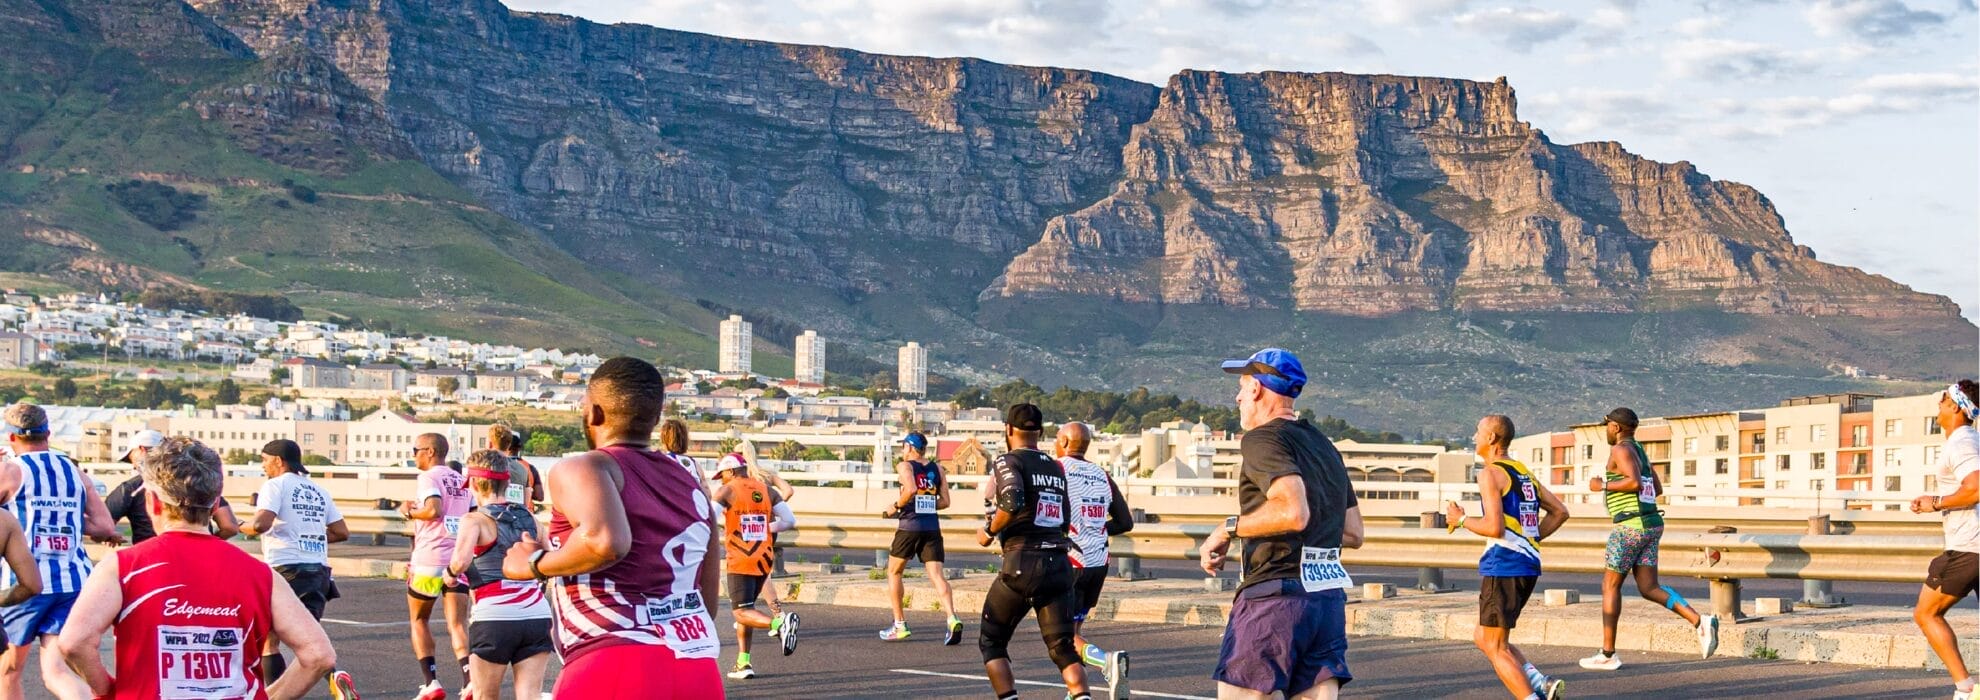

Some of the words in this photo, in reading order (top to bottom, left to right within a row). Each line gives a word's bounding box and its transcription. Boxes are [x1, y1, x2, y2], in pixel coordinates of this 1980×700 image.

[47, 535, 69, 551] 153
[1302, 563, 1346, 581] T39333
[163, 598, 241, 619] Edgemead
[670, 615, 708, 642] 884
[165, 635, 188, 645] WPA
[161, 652, 174, 679] P
[182, 652, 232, 680] 1307
